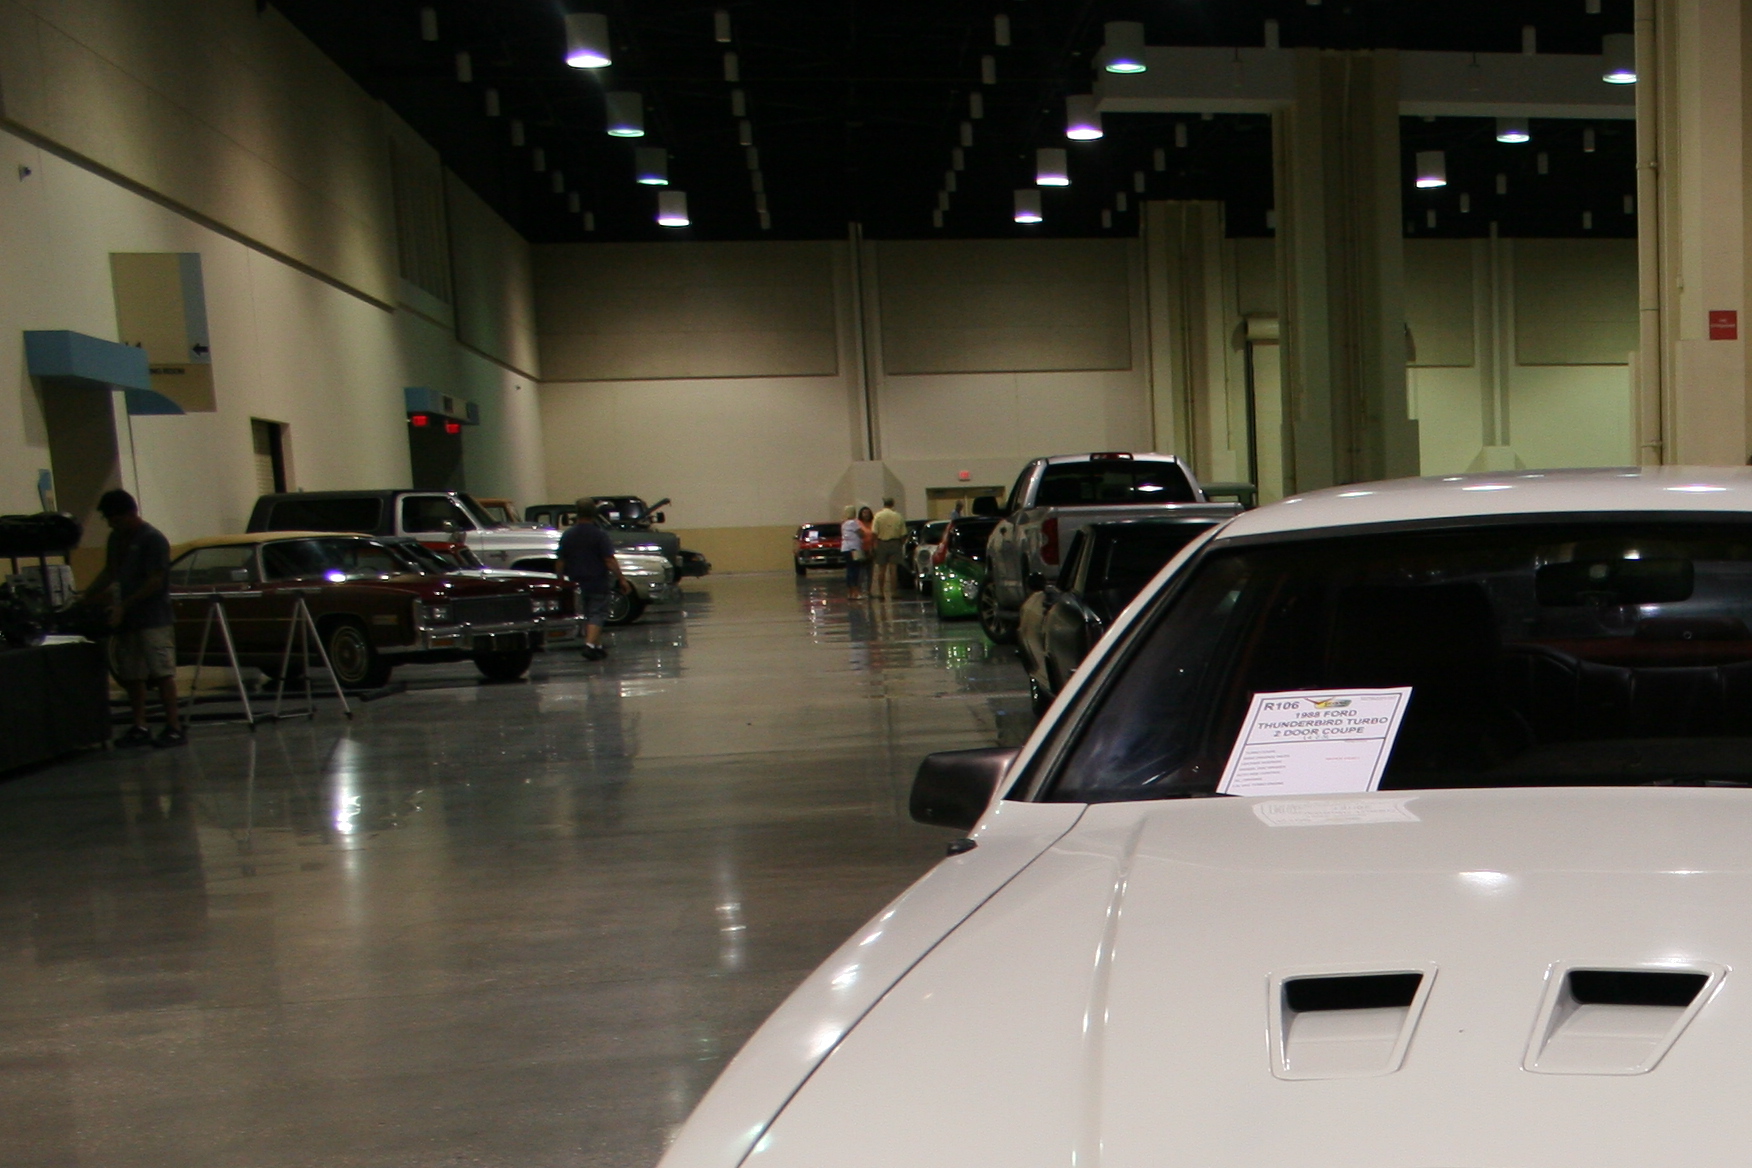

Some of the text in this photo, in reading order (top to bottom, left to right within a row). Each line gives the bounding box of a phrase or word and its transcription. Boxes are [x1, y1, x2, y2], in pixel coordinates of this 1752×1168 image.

[1263, 701, 1299, 711] R106
[1323, 710, 1357, 718] FORD
[1258, 717, 1388, 729] THUNDERBIRD TURBO
[1283, 728, 1319, 737] DOOR
[1322, 727, 1364, 735] COUPE
